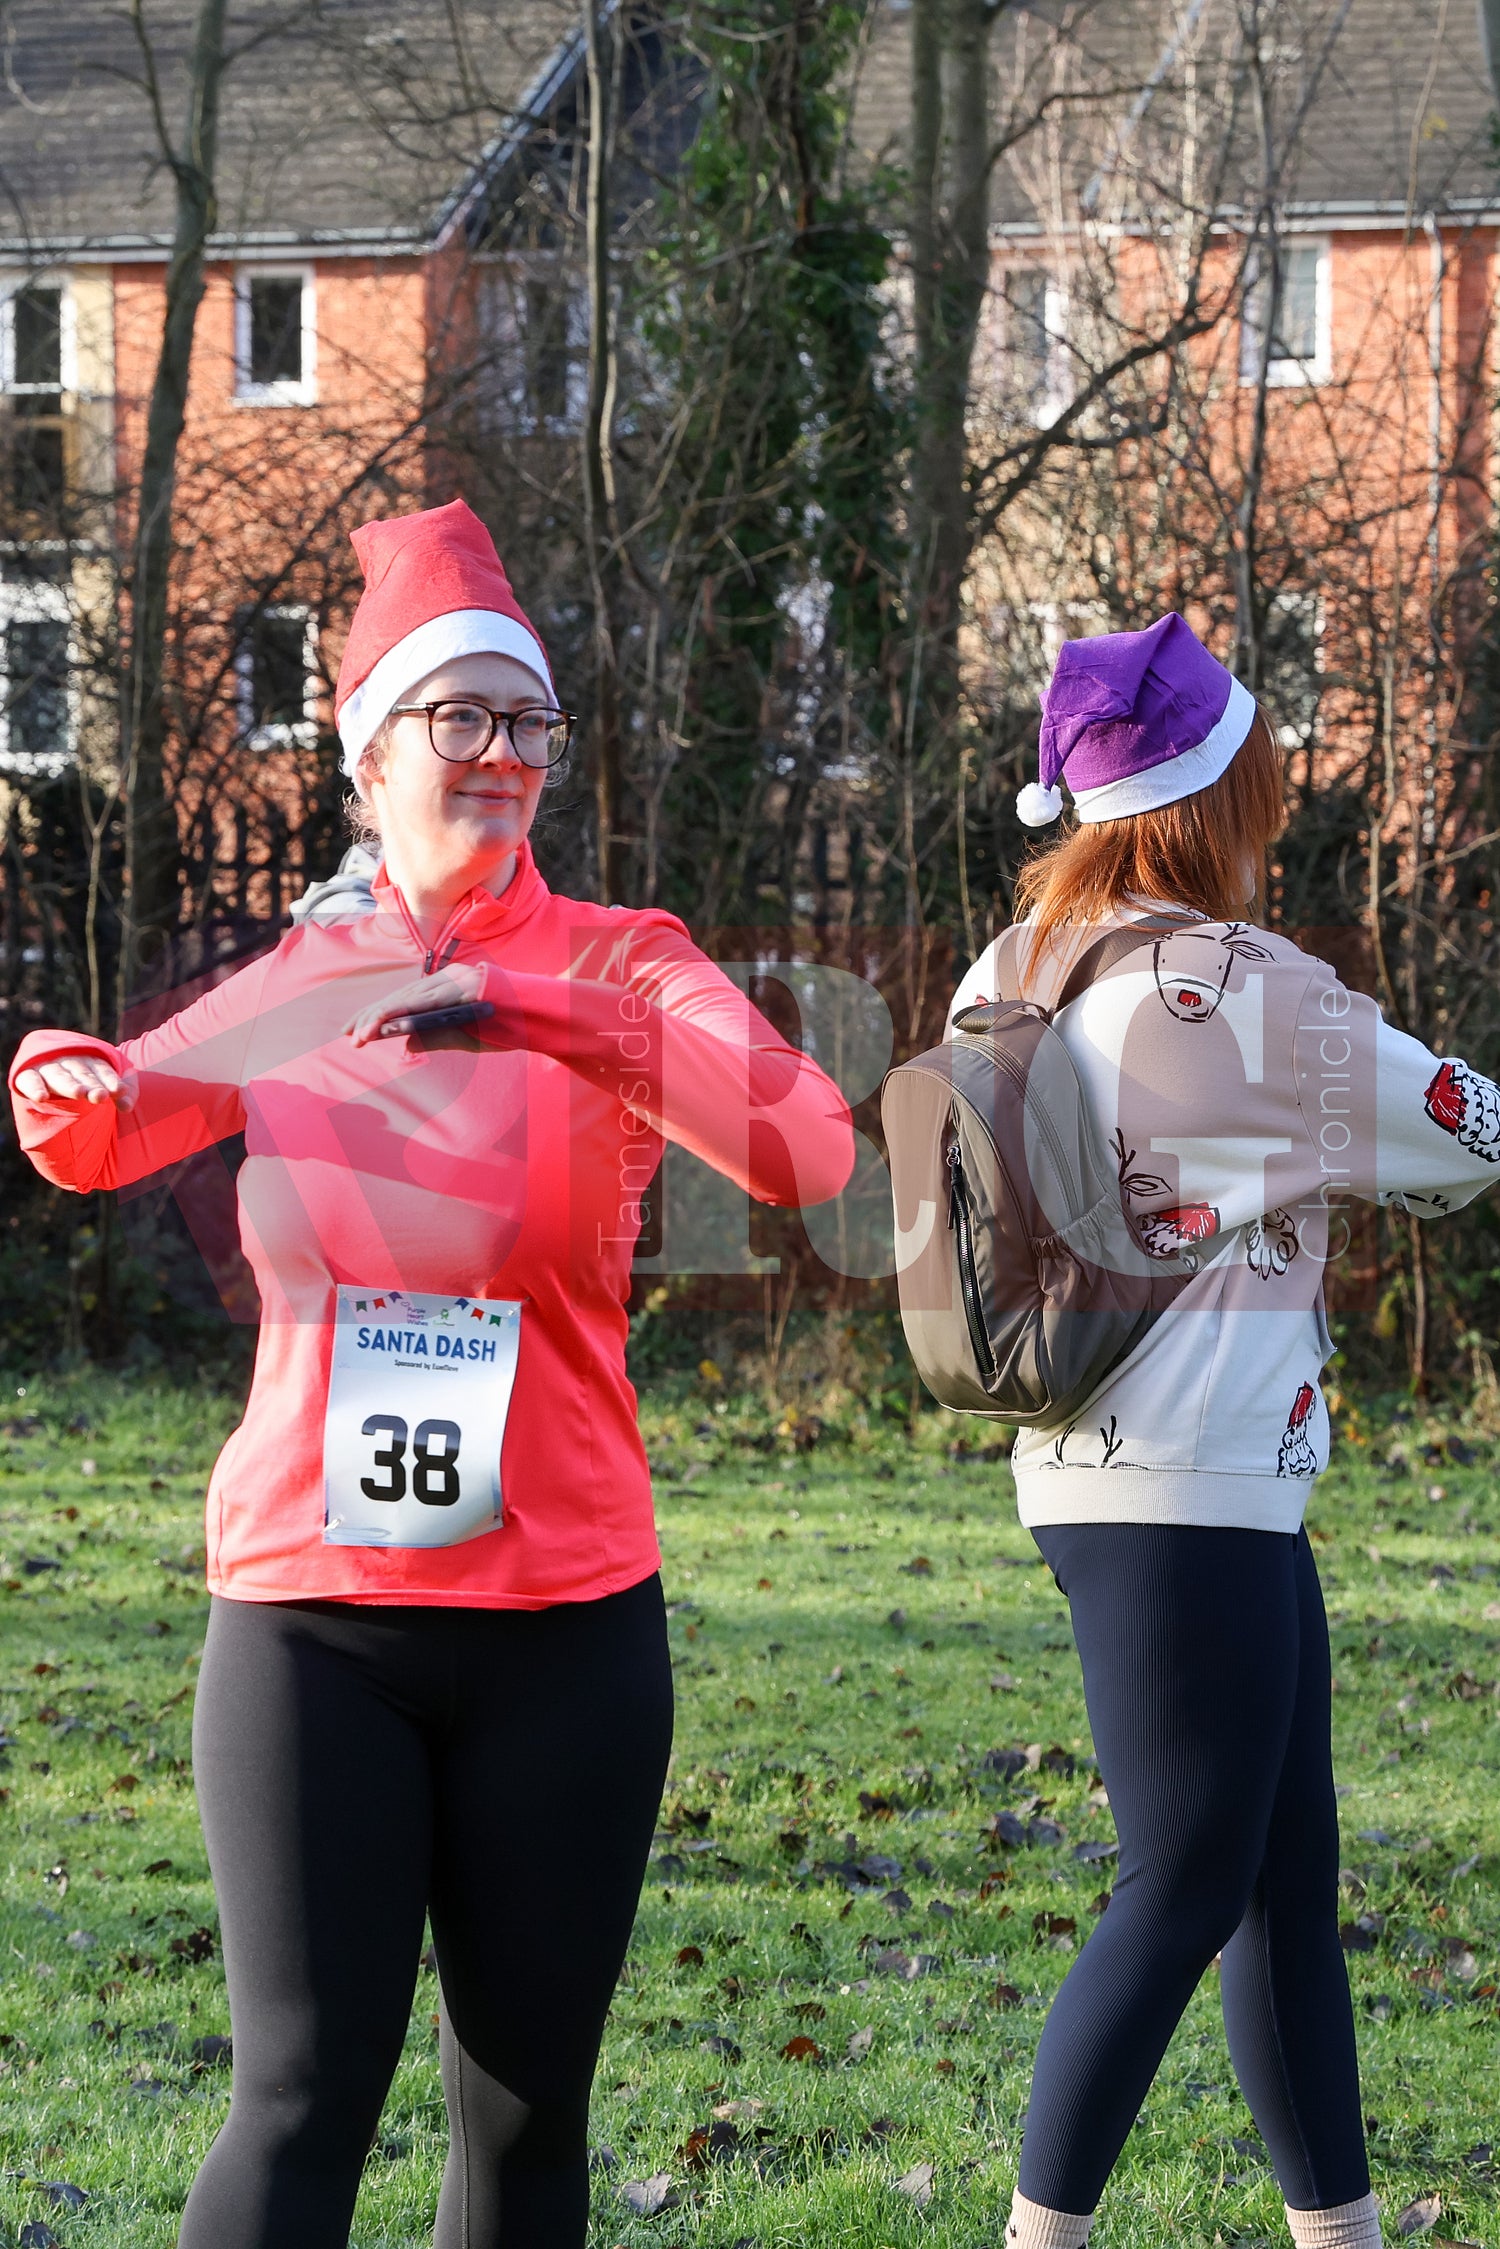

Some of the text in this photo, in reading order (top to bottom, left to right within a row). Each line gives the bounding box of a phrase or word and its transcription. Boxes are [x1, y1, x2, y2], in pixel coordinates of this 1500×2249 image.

[357, 1327, 497, 1362] SANTA DASH
[360, 1413, 461, 1507] 38
